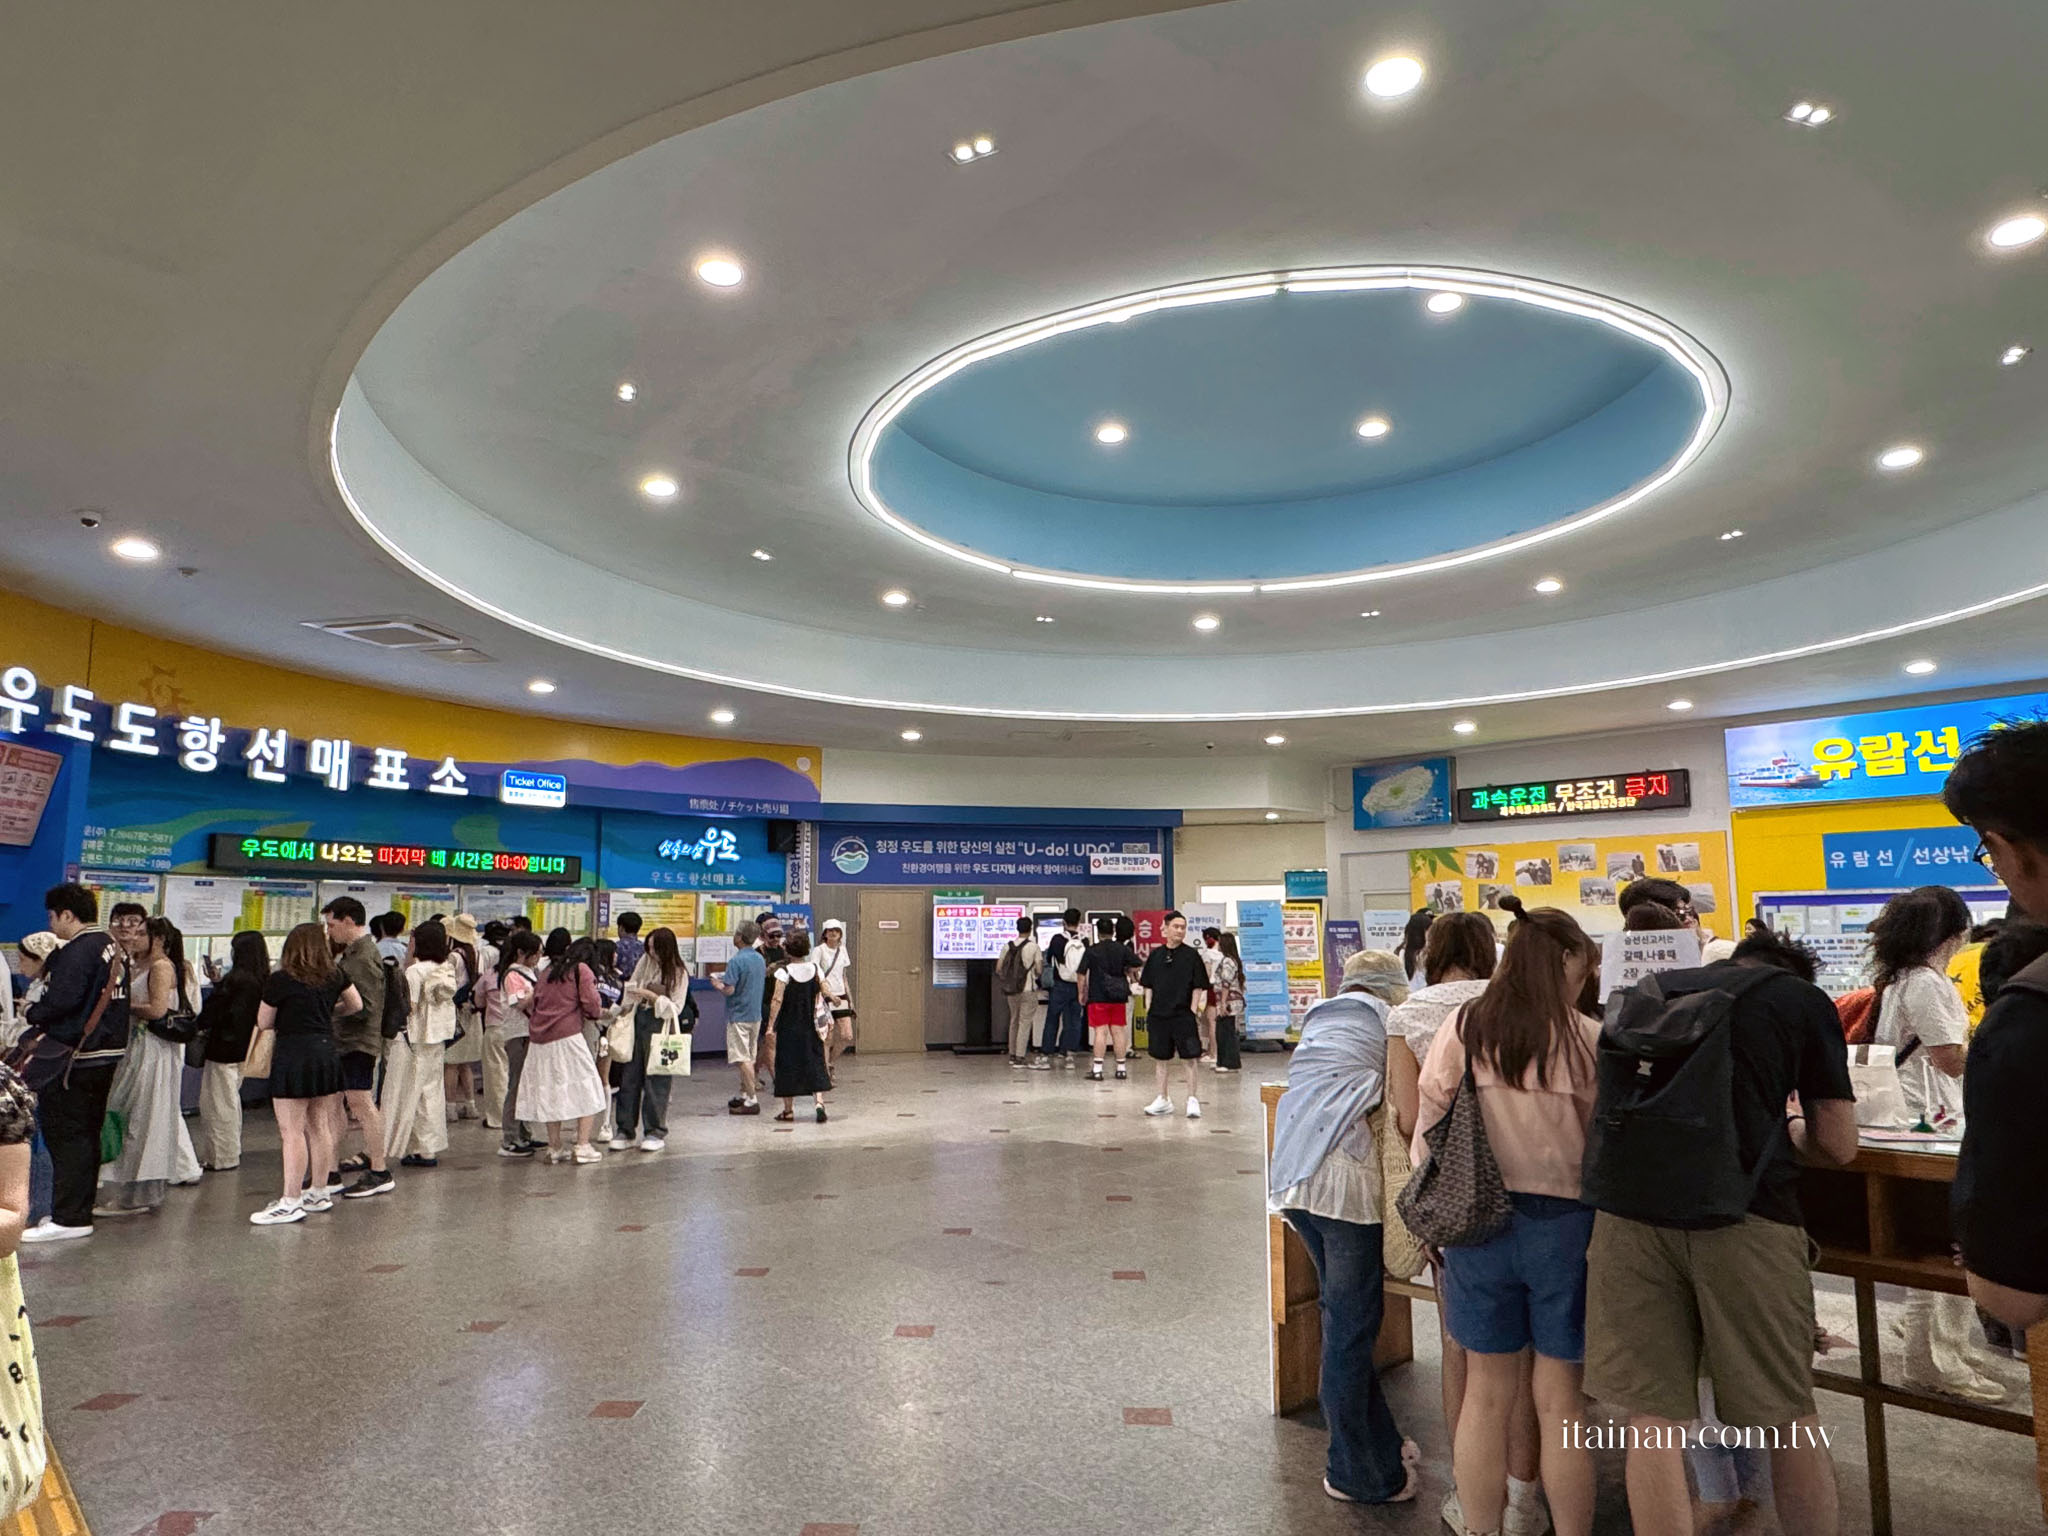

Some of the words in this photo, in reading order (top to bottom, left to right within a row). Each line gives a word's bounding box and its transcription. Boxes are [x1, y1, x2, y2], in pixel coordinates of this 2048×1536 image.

[1811, 726, 1961, 781] 유람선
[508, 775, 535, 787] Ticket
[537, 778, 562, 790] Office
[1471, 785, 1546, 810] 과속운전
[1554, 779, 1616, 803] 무조건
[1624, 775, 1669, 798] 금지
[241, 838, 315, 861] 우도에서
[320, 842, 374, 864] 나오는
[377, 846, 426, 867] 마지막
[431, 850, 446, 868] 배
[698, 826, 742, 866] 우도
[875, 840, 898, 854] 청정
[901, 840, 933, 854] 우도를
[936, 840, 958, 854] 위한
[960, 841, 992, 855] 당신의
[972, 863, 990, 874] 우도
